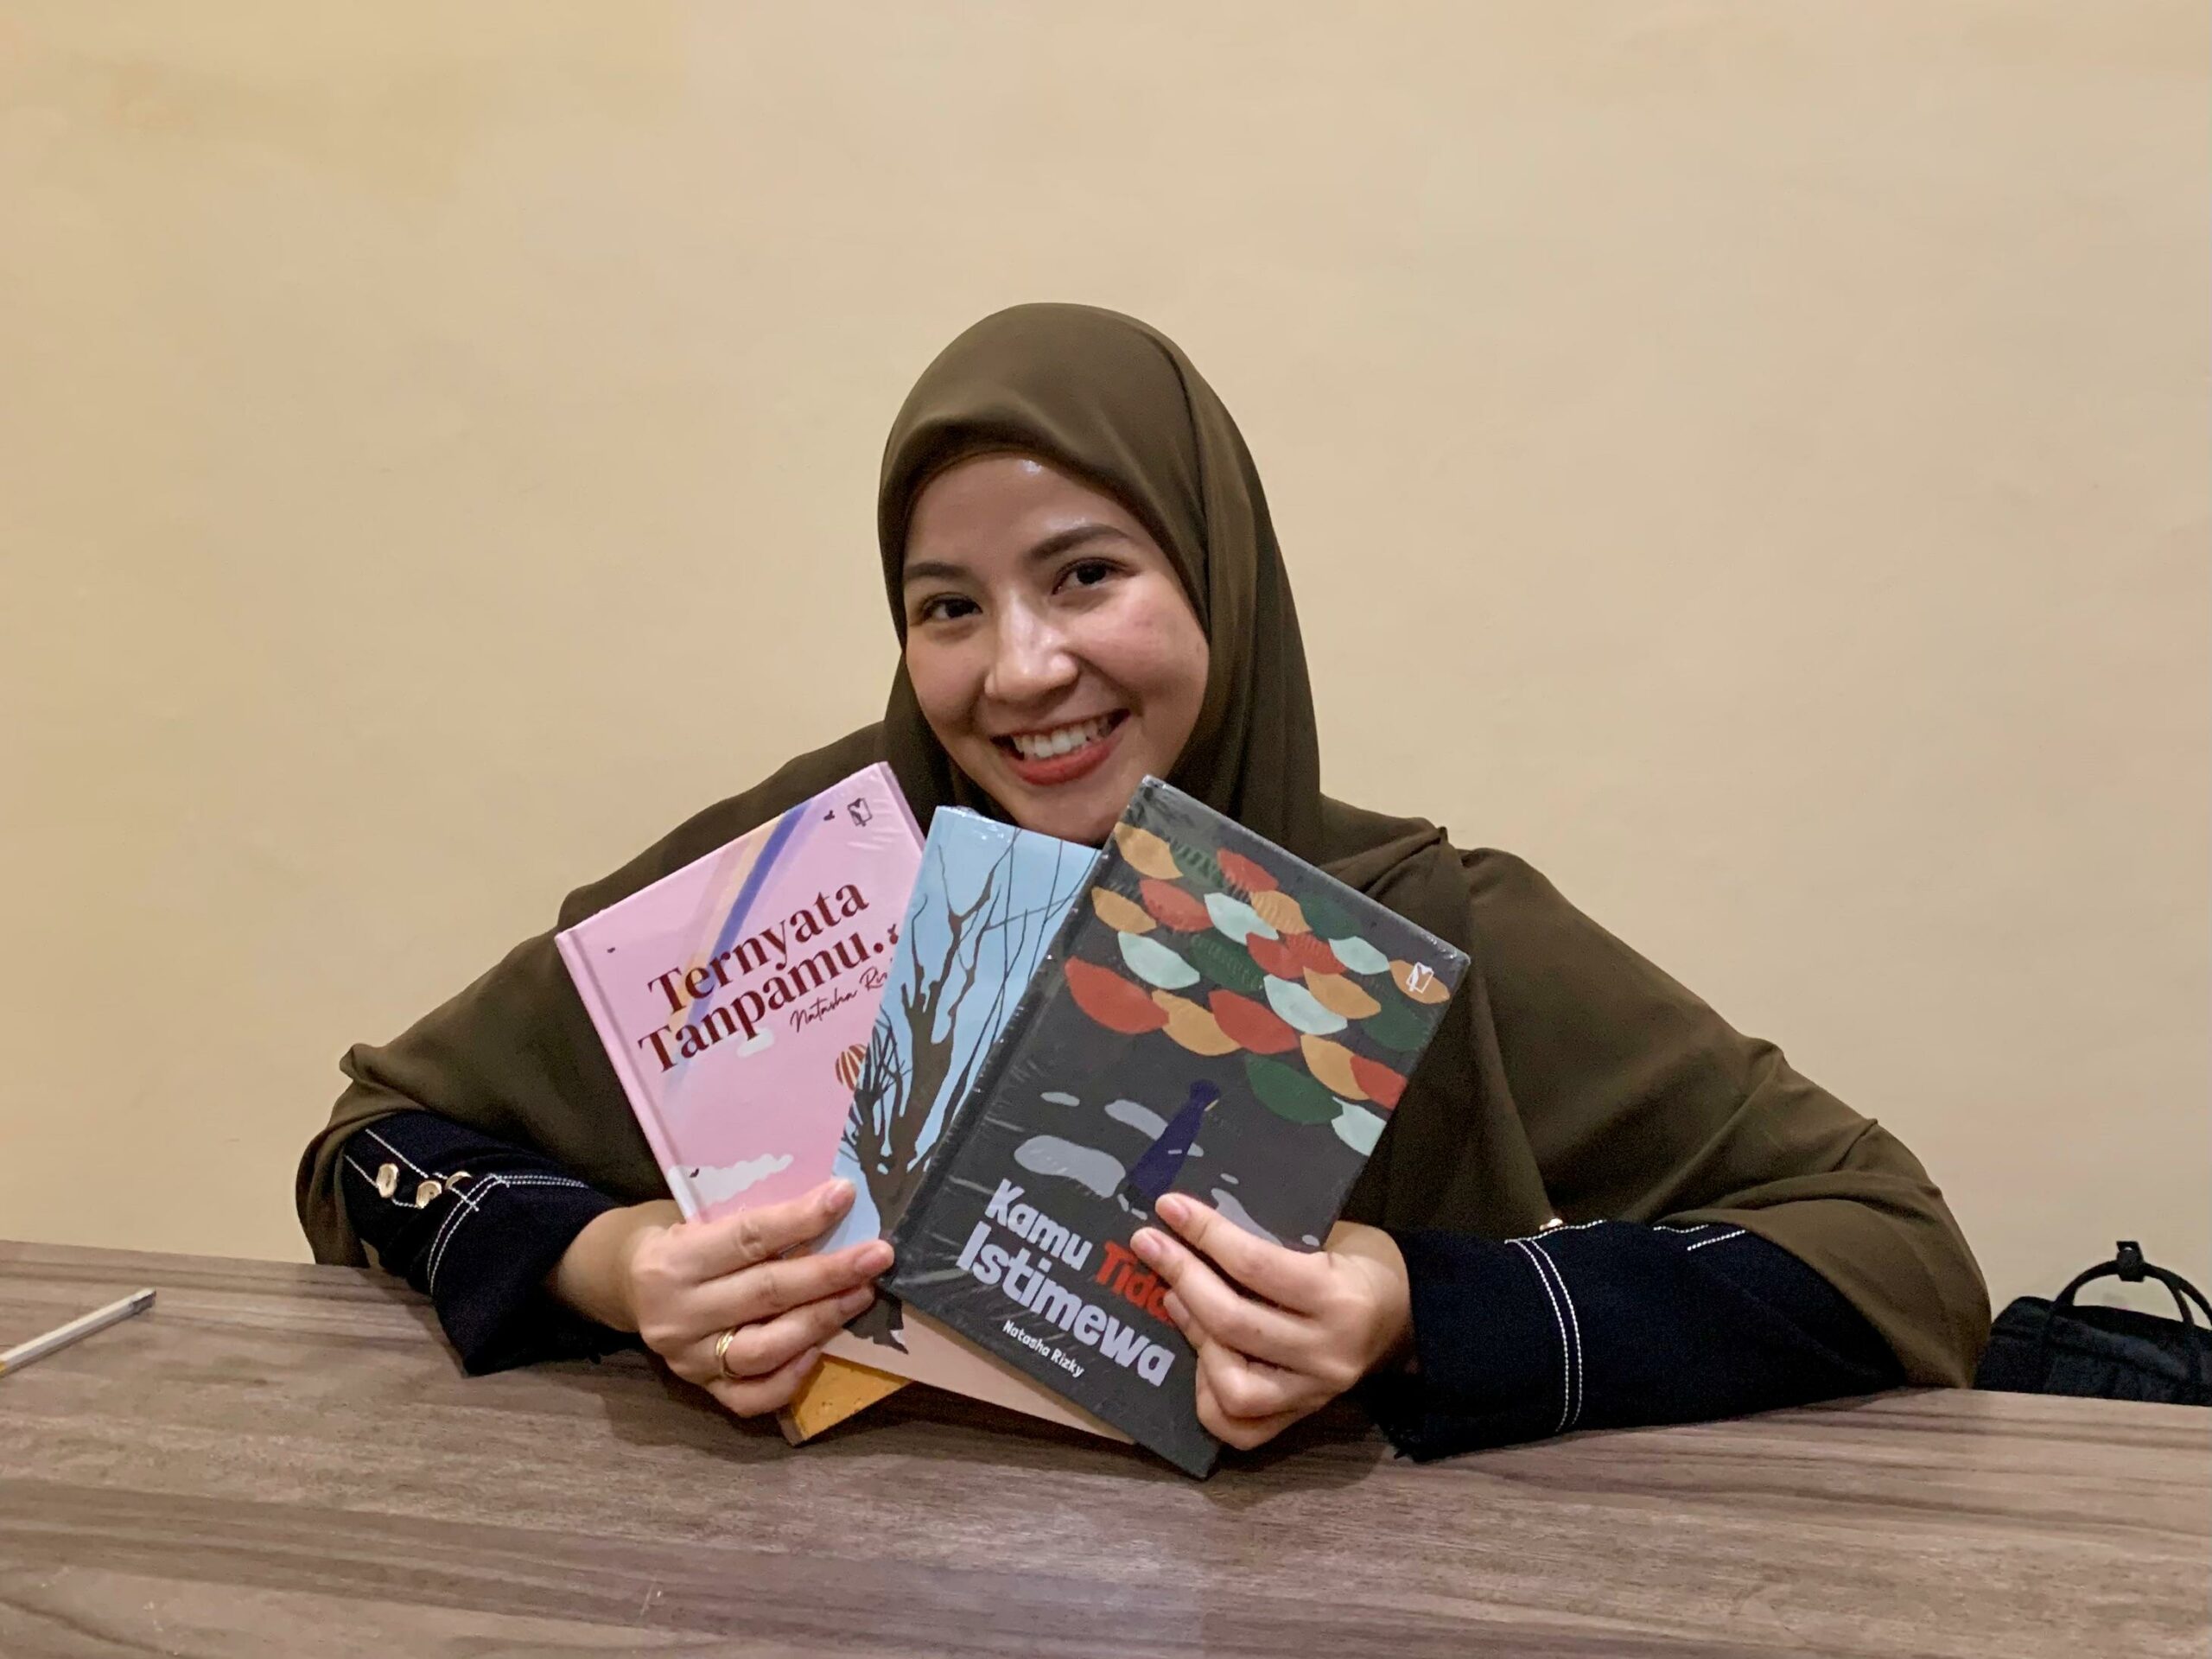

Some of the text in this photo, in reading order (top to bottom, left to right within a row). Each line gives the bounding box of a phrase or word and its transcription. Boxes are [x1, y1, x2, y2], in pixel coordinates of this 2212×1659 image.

[646, 883, 869, 1016] Ternyata
[789, 987, 858, 1033] Natasha
[955, 1220, 1176, 1387] Istimewa
[984, 1178, 1176, 1328] Kamu Tida
[1002, 1319, 1085, 1378] Natasha Rizky
